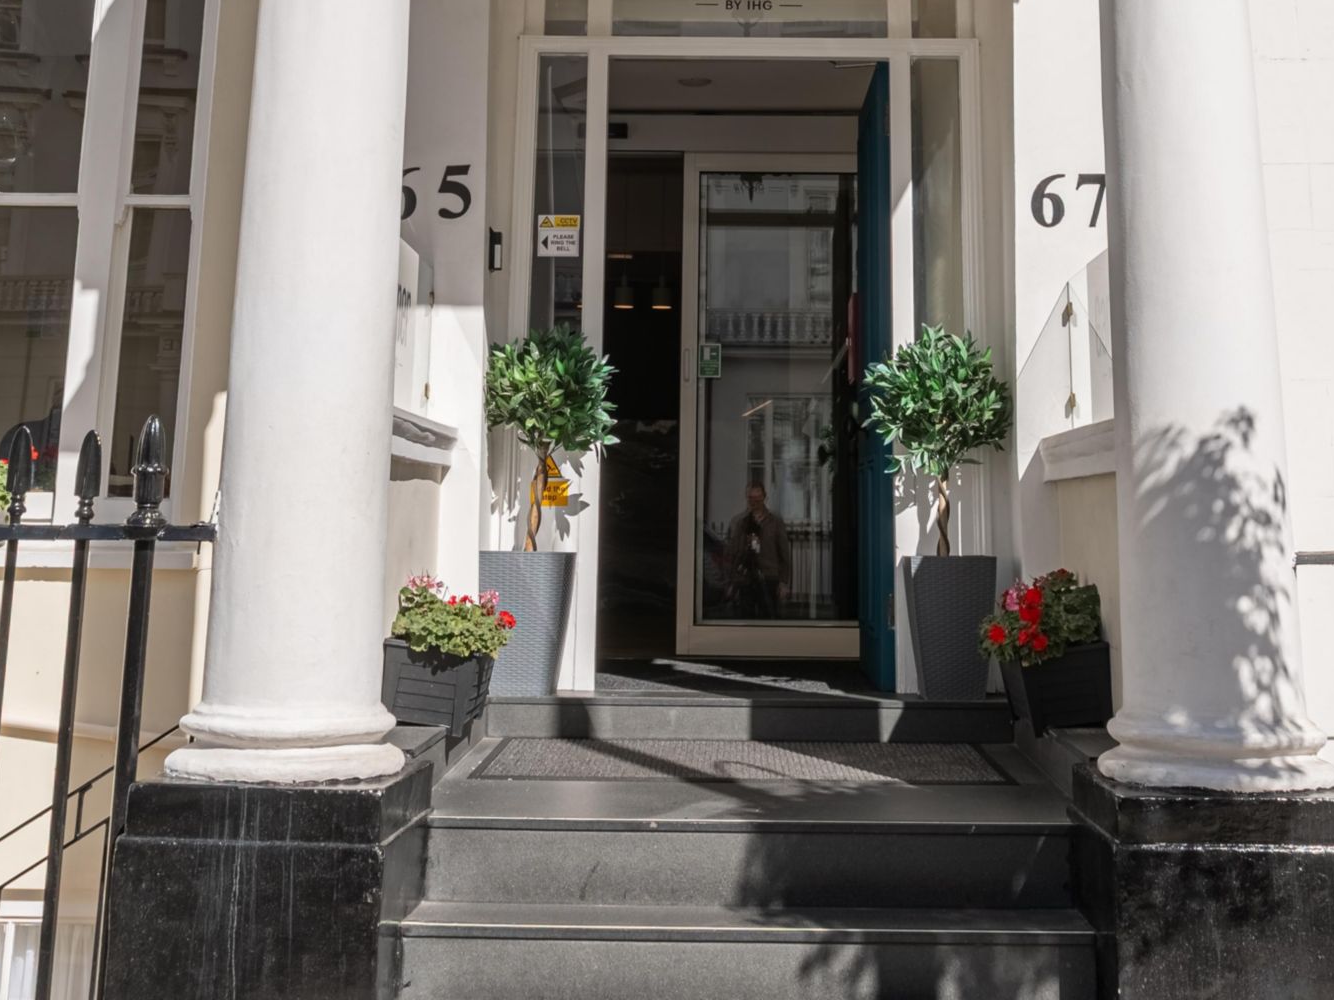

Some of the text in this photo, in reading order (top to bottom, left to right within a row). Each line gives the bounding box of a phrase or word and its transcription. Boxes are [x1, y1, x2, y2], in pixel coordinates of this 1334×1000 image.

[725, 0, 773, 11] BY IHG
[1030, 173, 1106, 228] 67
